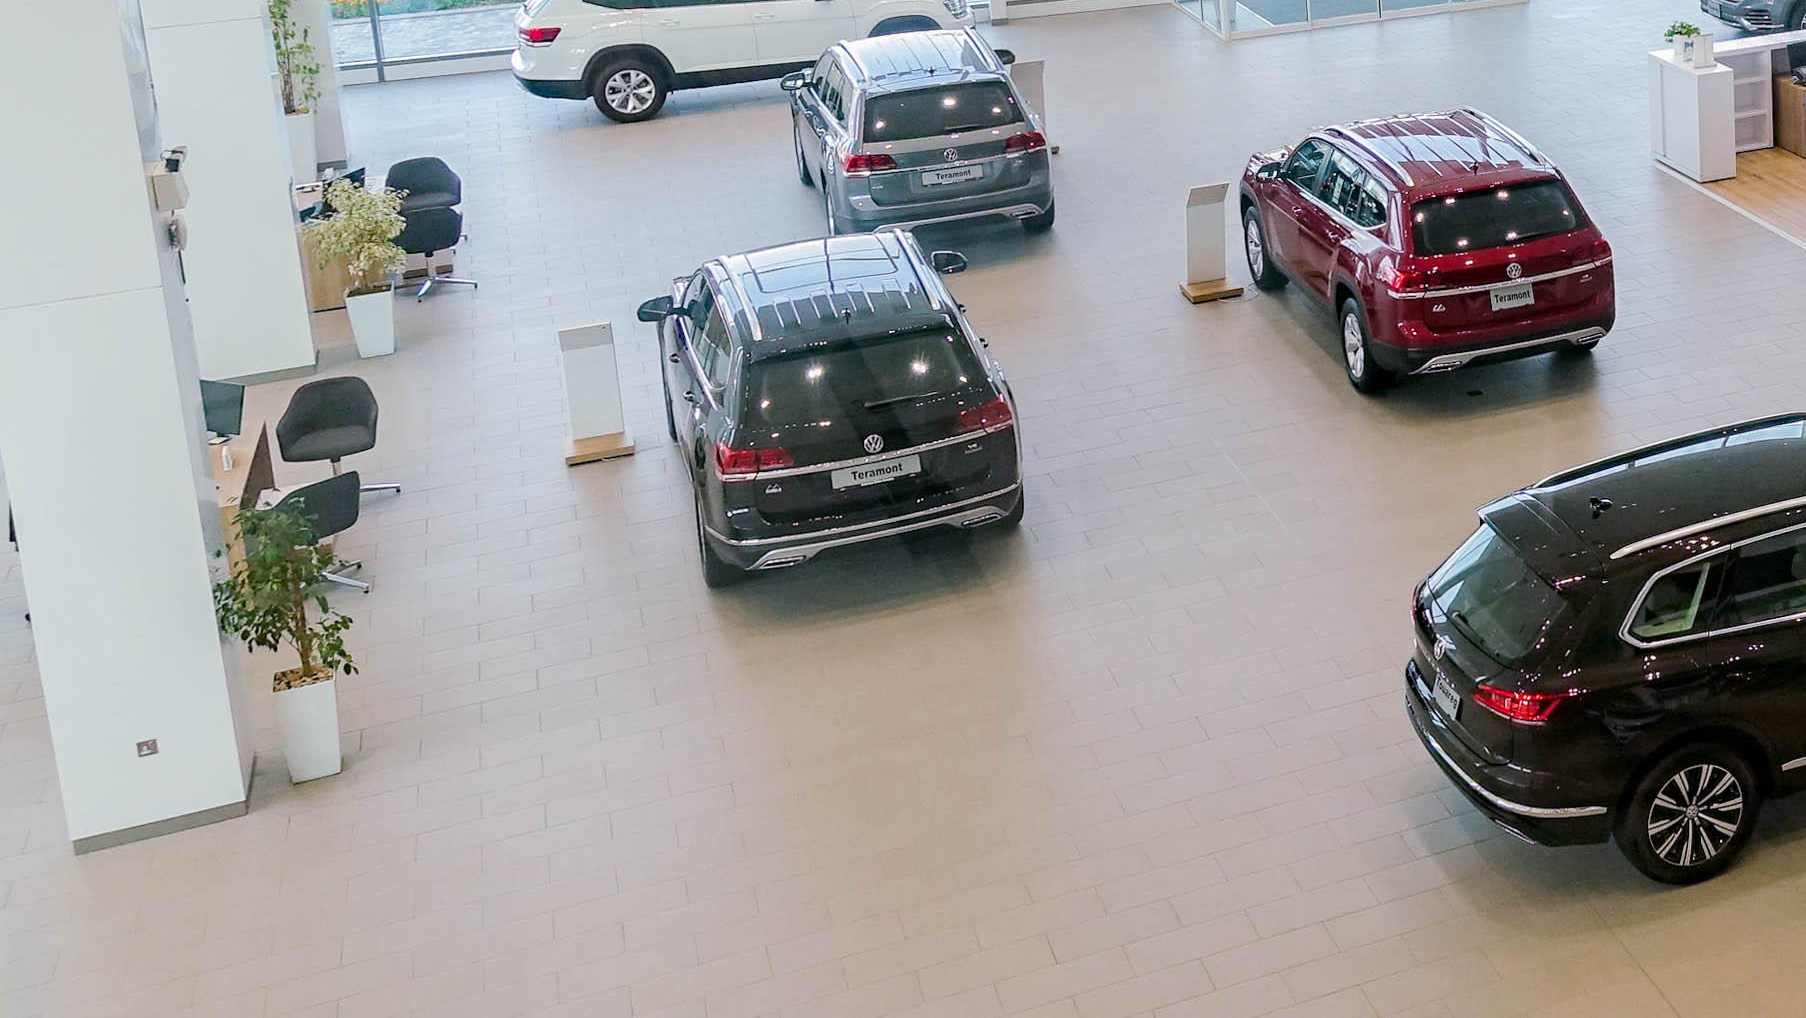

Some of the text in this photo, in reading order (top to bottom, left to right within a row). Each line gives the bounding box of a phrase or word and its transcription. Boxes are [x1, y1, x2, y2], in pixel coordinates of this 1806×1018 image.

[935, 169, 972, 181] Teramont
[1494, 290, 1531, 303] Teramont
[851, 462, 904, 481] Teramont
